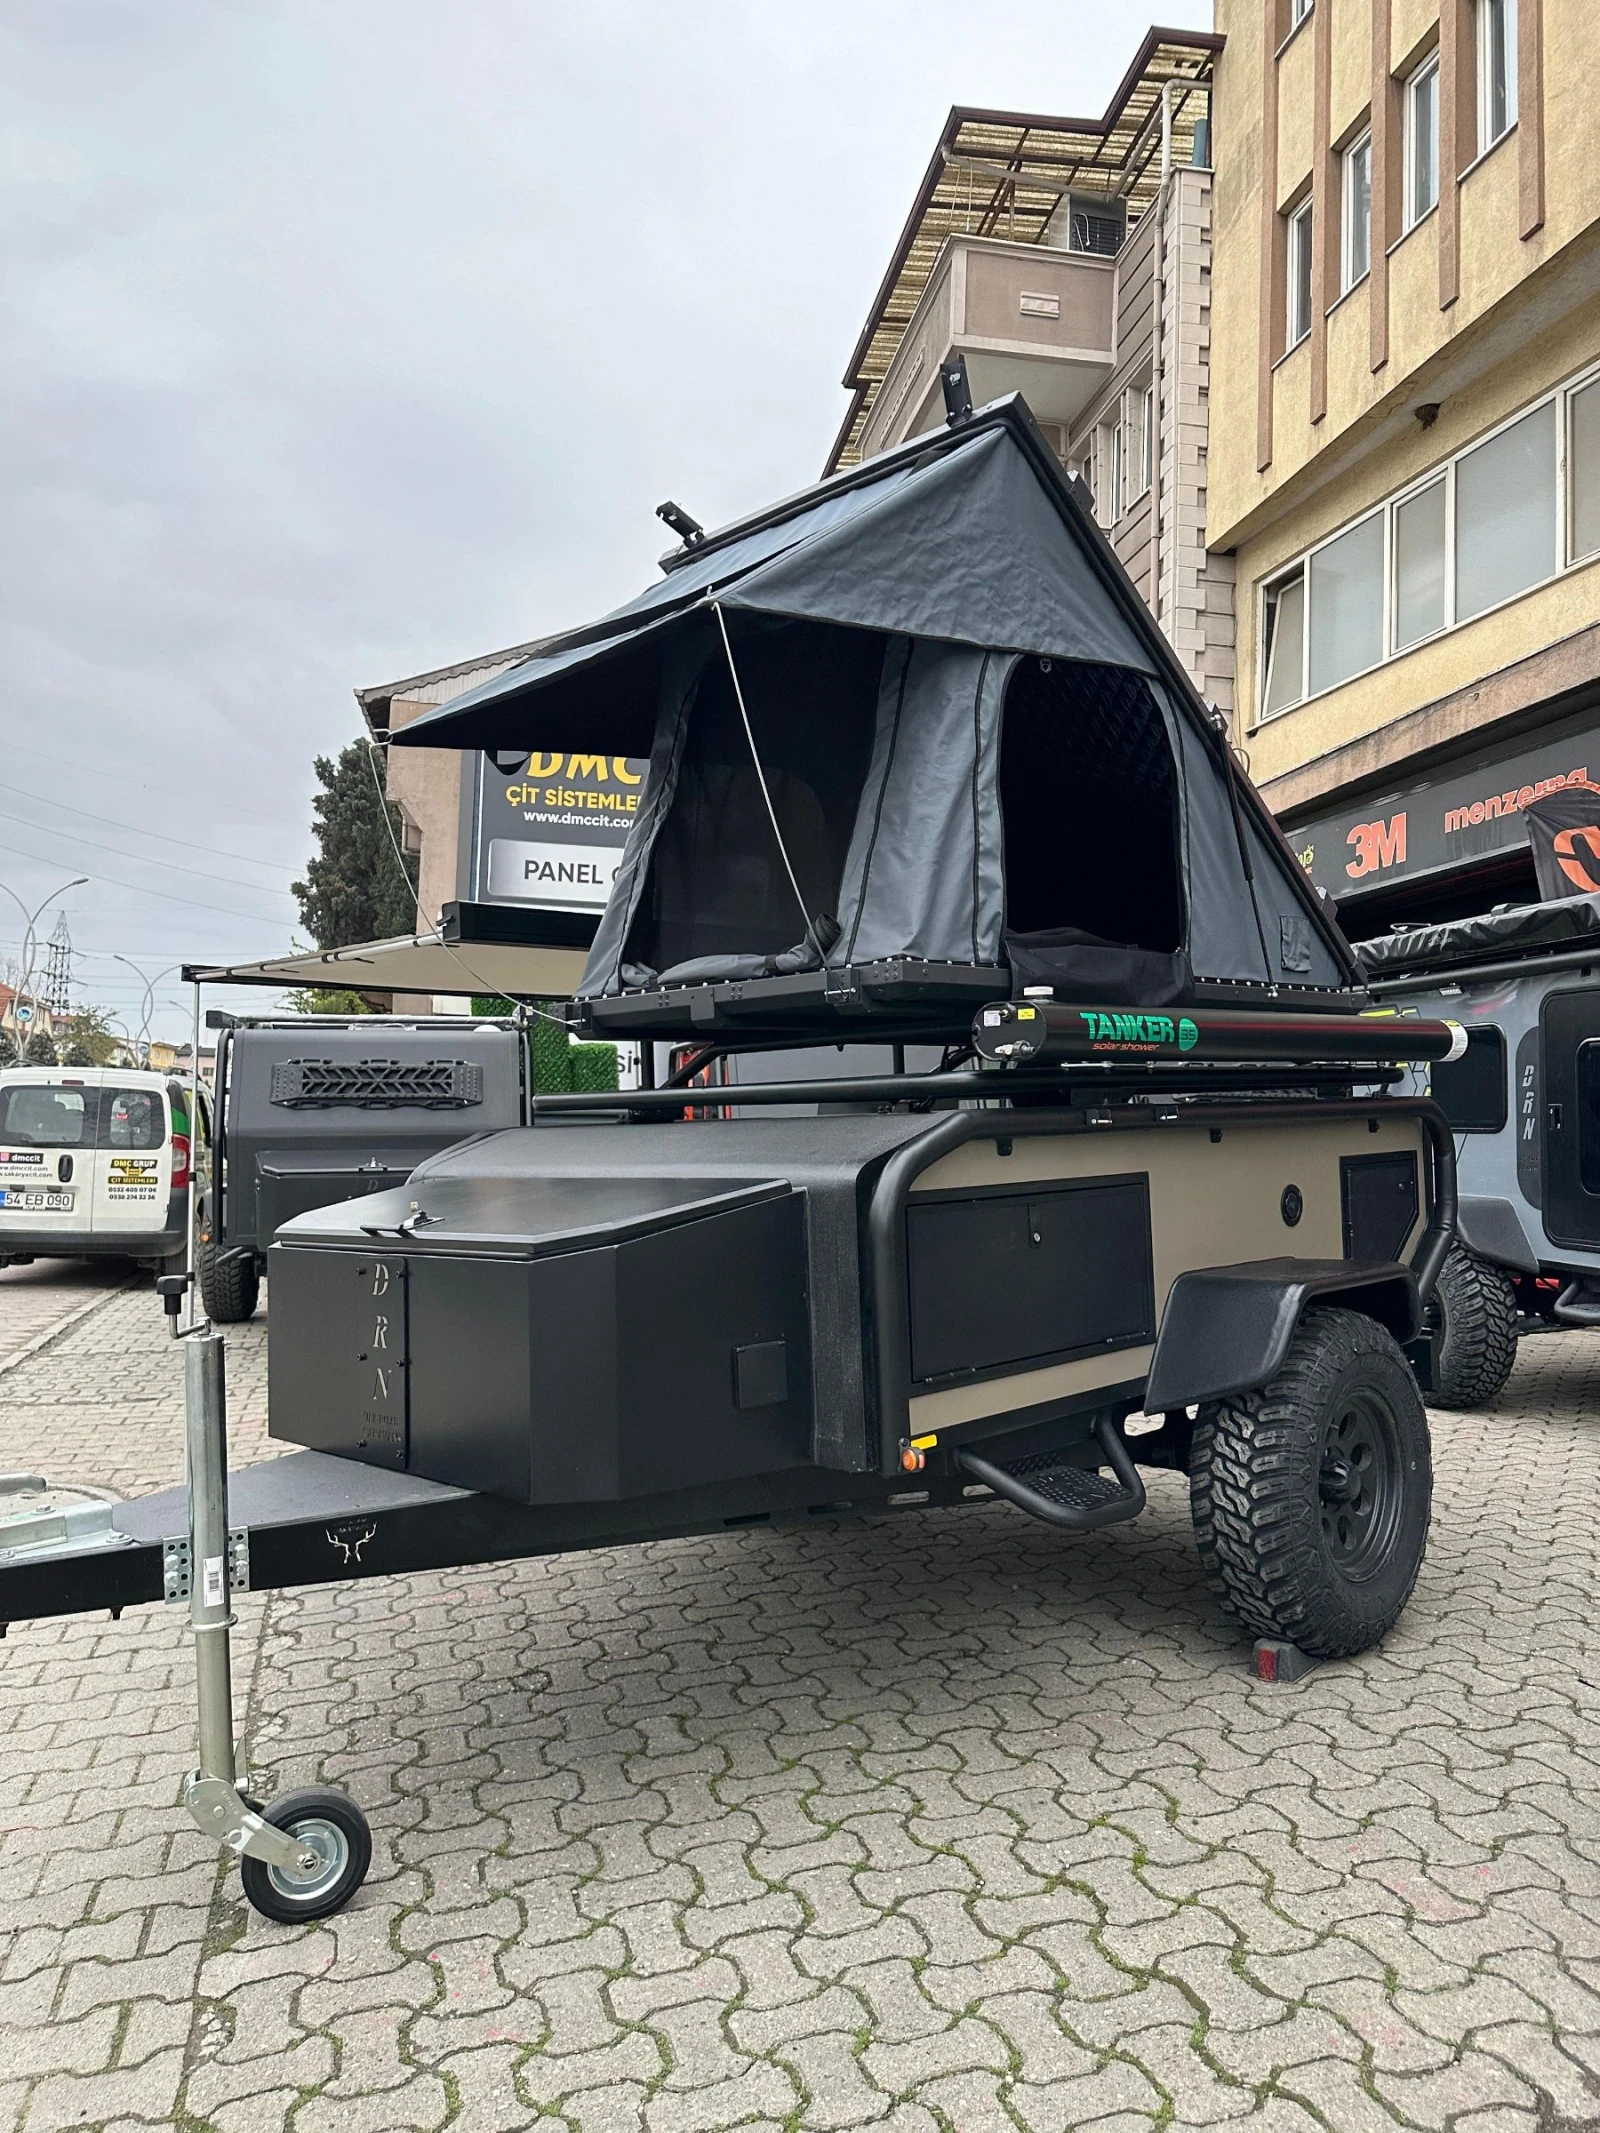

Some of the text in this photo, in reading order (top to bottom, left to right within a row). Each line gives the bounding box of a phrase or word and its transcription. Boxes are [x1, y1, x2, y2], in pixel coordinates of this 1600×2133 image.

[526, 751, 641, 785] DMC
[505, 782, 641, 812] ÇİT SİSTEMLE
[1346, 812, 1407, 878] 3M
[524, 860, 604, 885] PANEL
[1080, 1012, 1175, 1042] TANKER
[1092, 1042, 1160, 1052] solar shower
[11, 1153, 41, 1162] dmccit
[6, 1193, 70, 1206] 54 EB 090
